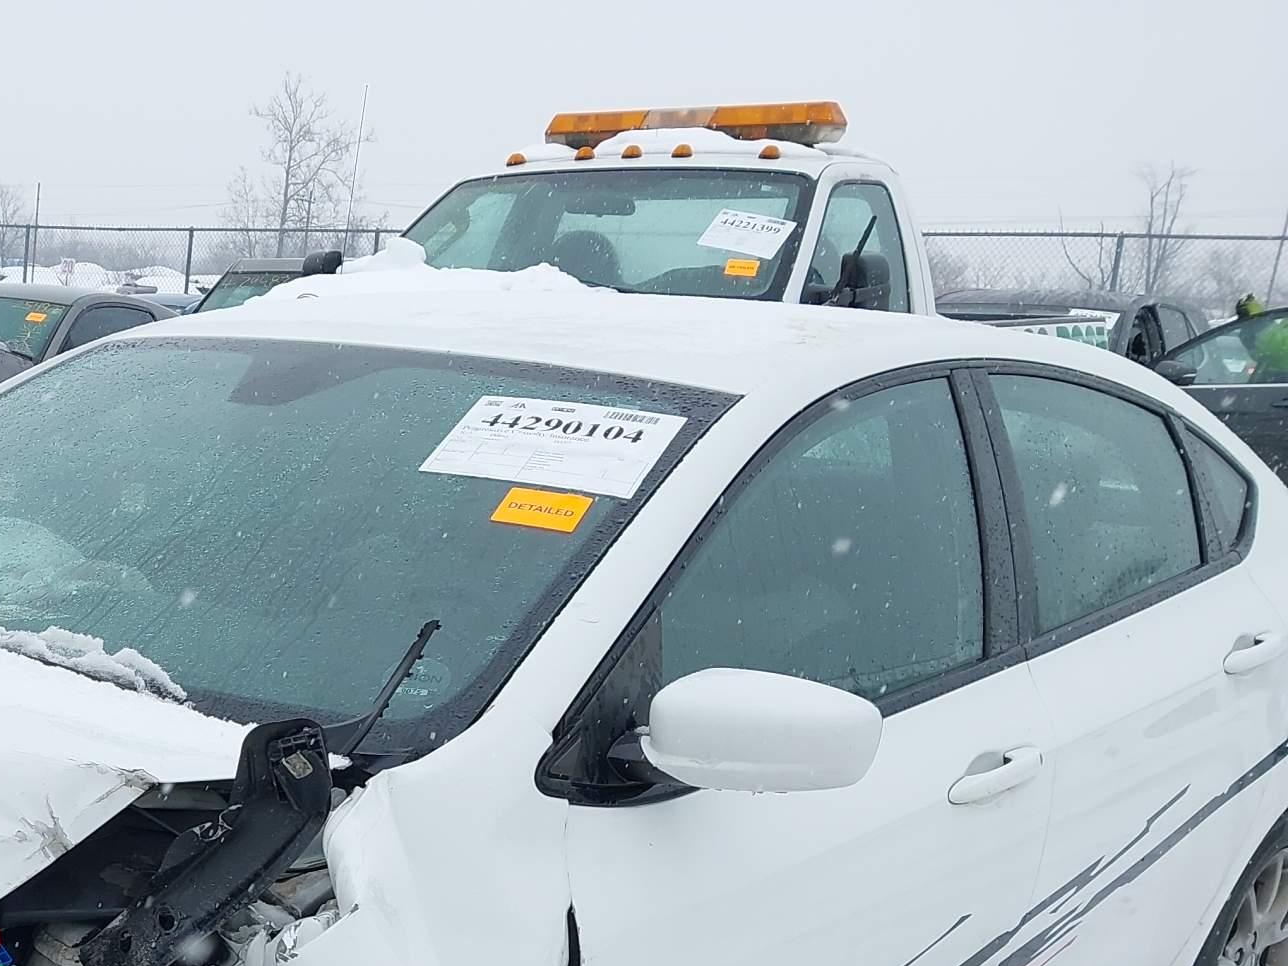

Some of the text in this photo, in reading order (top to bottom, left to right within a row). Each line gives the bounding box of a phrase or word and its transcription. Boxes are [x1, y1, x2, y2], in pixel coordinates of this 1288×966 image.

[720, 218, 780, 233] 44221399
[481, 413, 645, 443] 44290104
[508, 501, 575, 517] DETAILED
